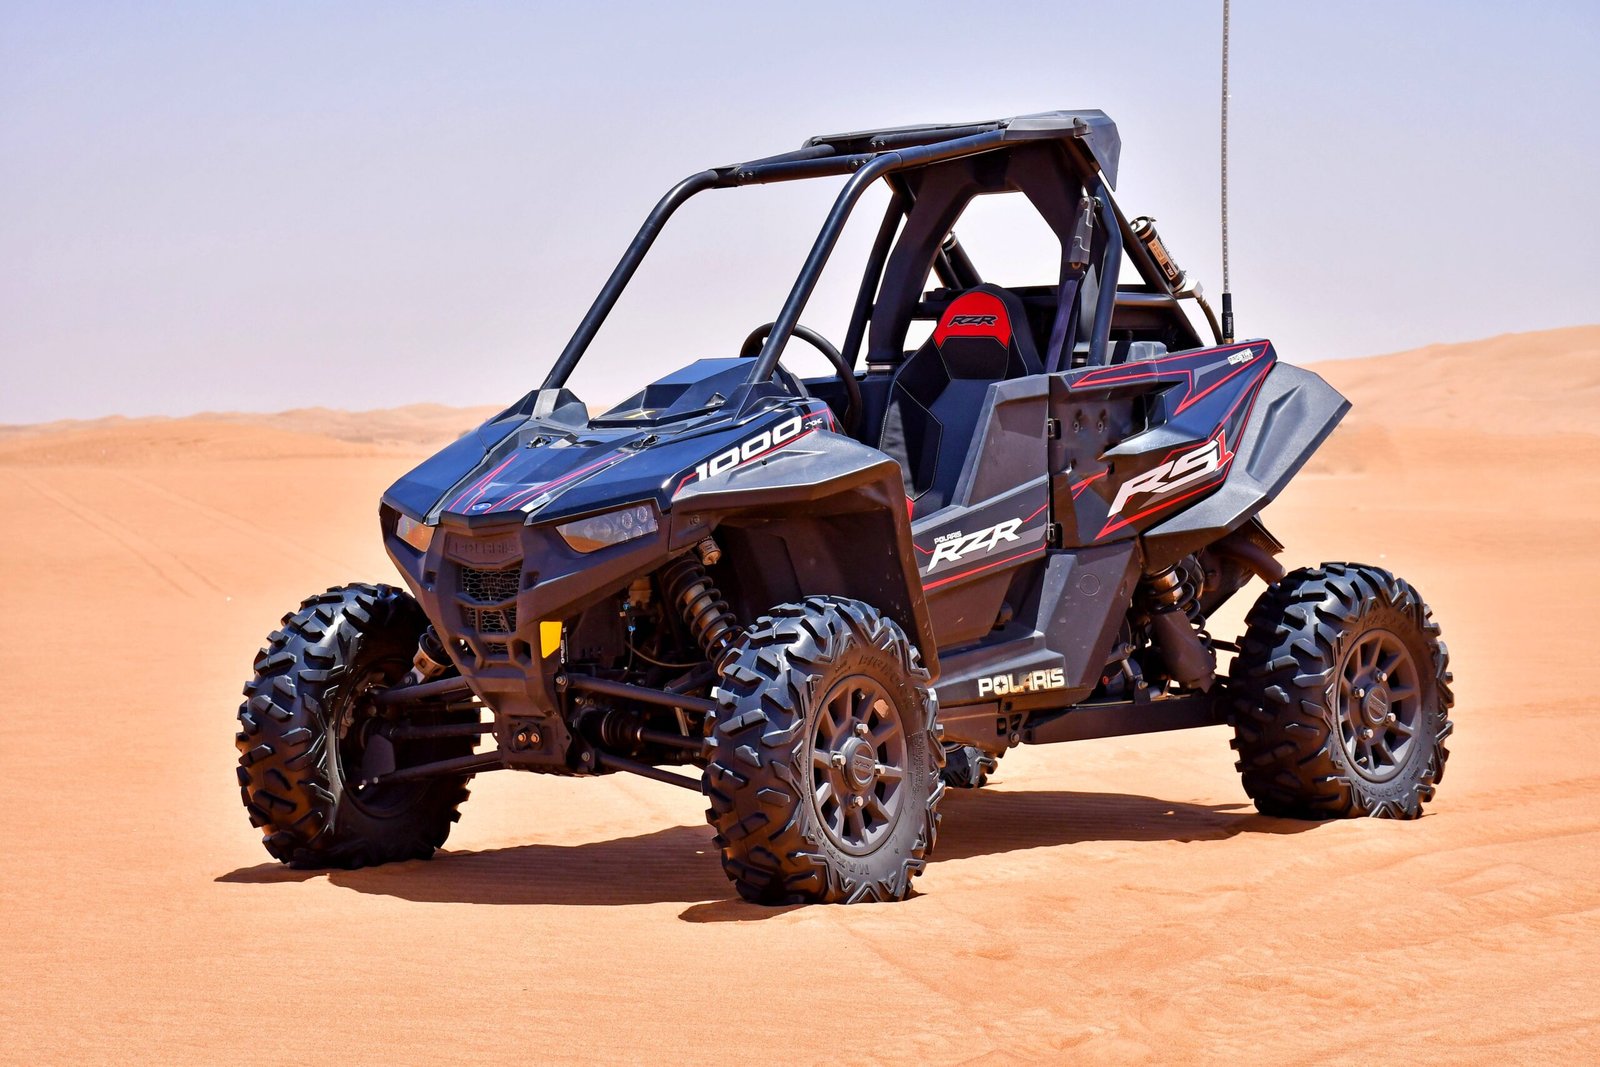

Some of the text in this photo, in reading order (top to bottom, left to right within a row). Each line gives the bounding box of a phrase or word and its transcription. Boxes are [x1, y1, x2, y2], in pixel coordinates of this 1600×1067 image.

[946, 314, 999, 327] RZR
[695, 415, 802, 482] 1000
[1107, 428, 1235, 517] RS1
[926, 517, 1023, 573] RZR
[933, 530, 963, 545] POLARIS
[978, 667, 1065, 697] POLARIS
